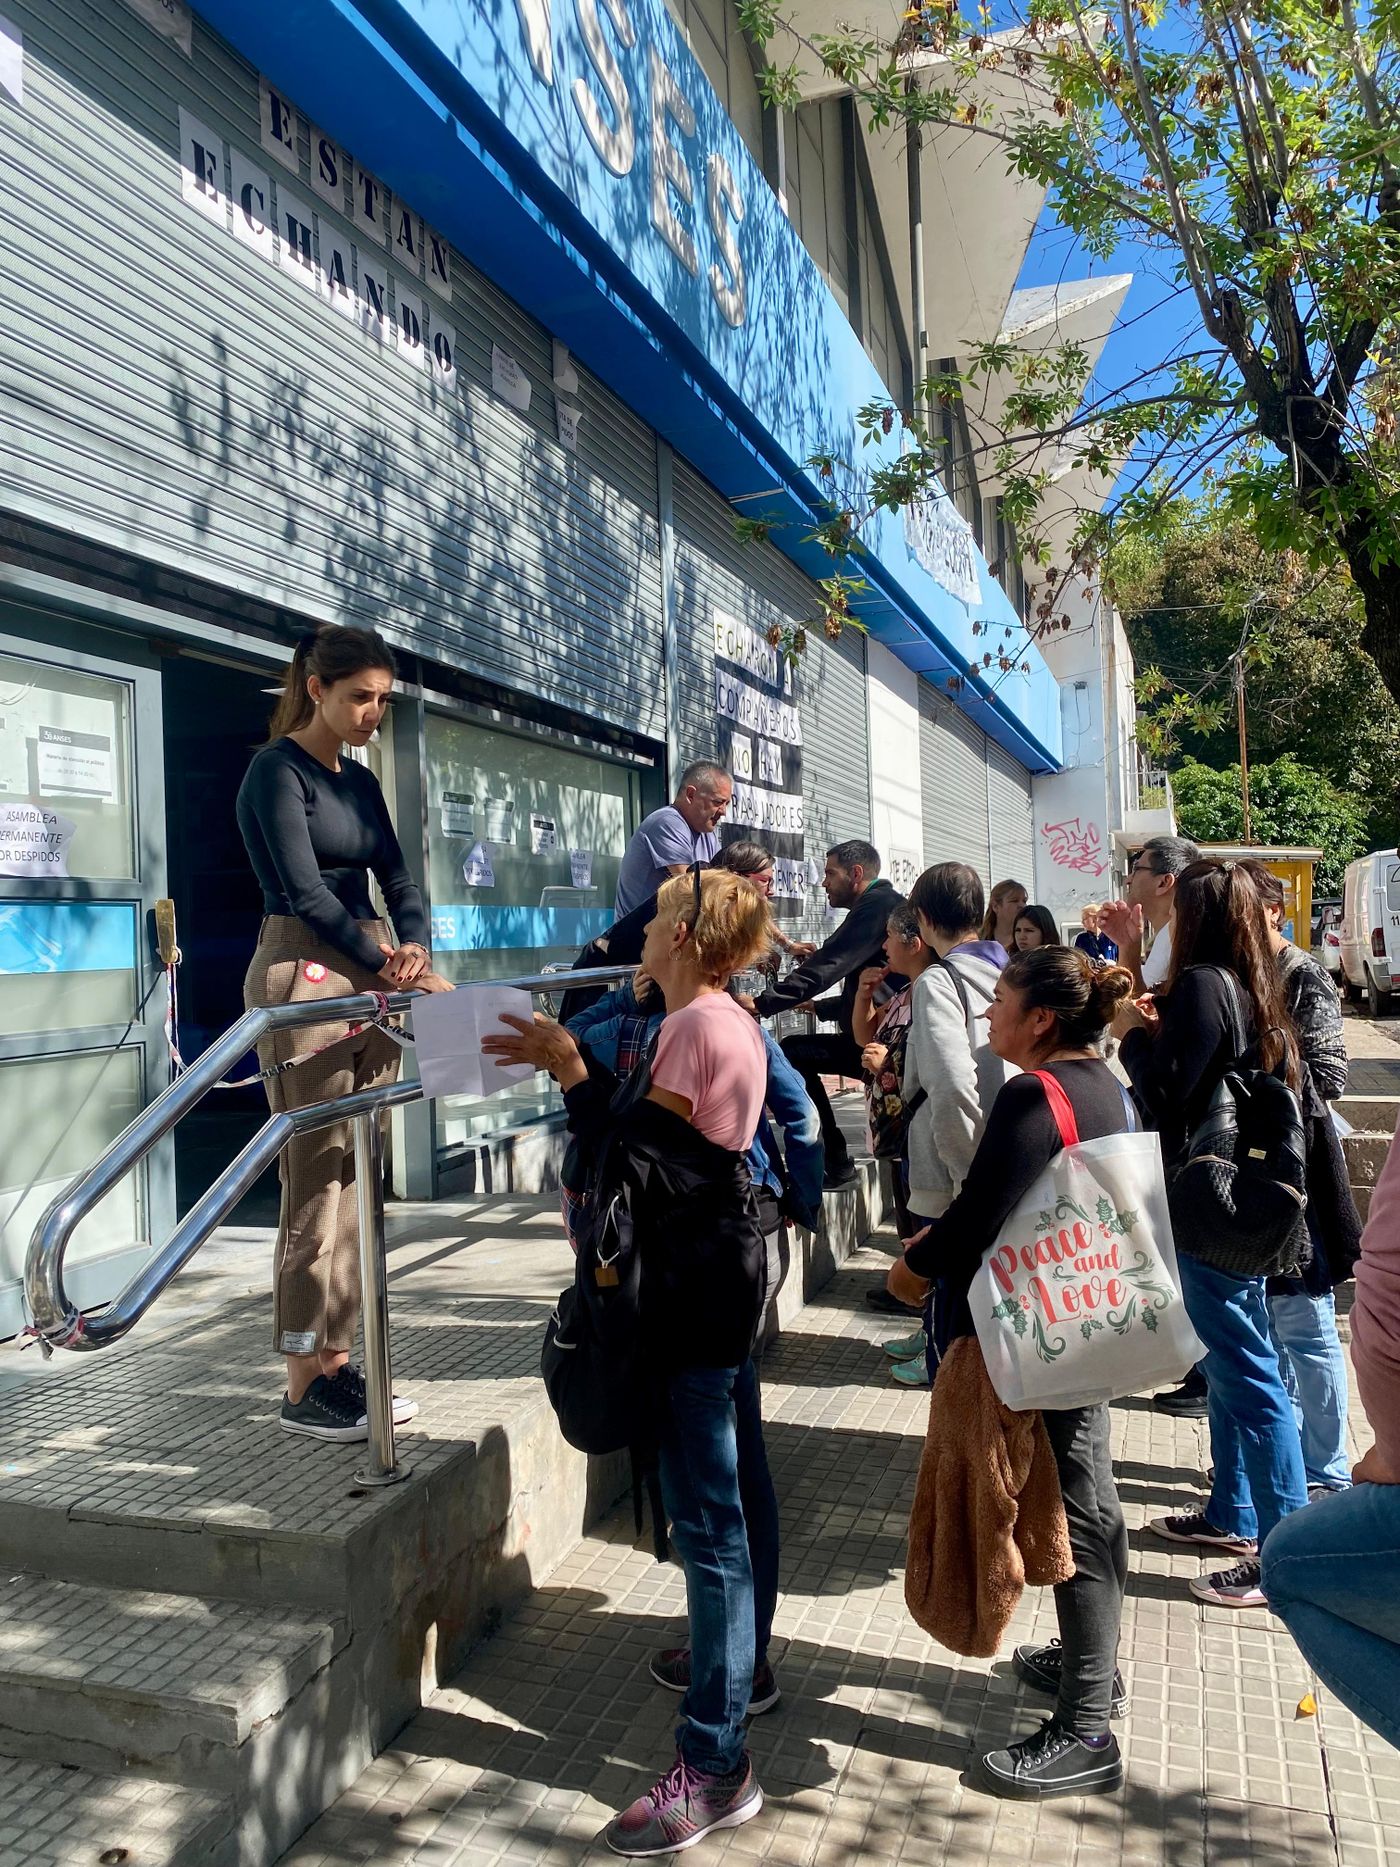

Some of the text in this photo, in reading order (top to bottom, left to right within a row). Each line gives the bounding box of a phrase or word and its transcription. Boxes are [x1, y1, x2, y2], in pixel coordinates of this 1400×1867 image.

[268, 90, 449, 285] ESTAN
[513, 0, 746, 330] SES
[191, 139, 453, 372] ECHANDO
[716, 623, 776, 682] ECHARON
[718, 684, 797, 741] COMPAÑEROS
[733, 745, 781, 777] NO HAY
[6, 811, 57, 825] ASAMBLEA
[731, 793, 804, 829] RABAJADORES
[0, 830, 63, 844] ERMANENTE
[14, 850, 61, 862] DESPIDOS
[772, 868, 805, 894] ENDER
[988, 1221, 1093, 1294] Peace
[1073, 1243, 1122, 1273] and
[1027, 1275, 1127, 1331] Love
